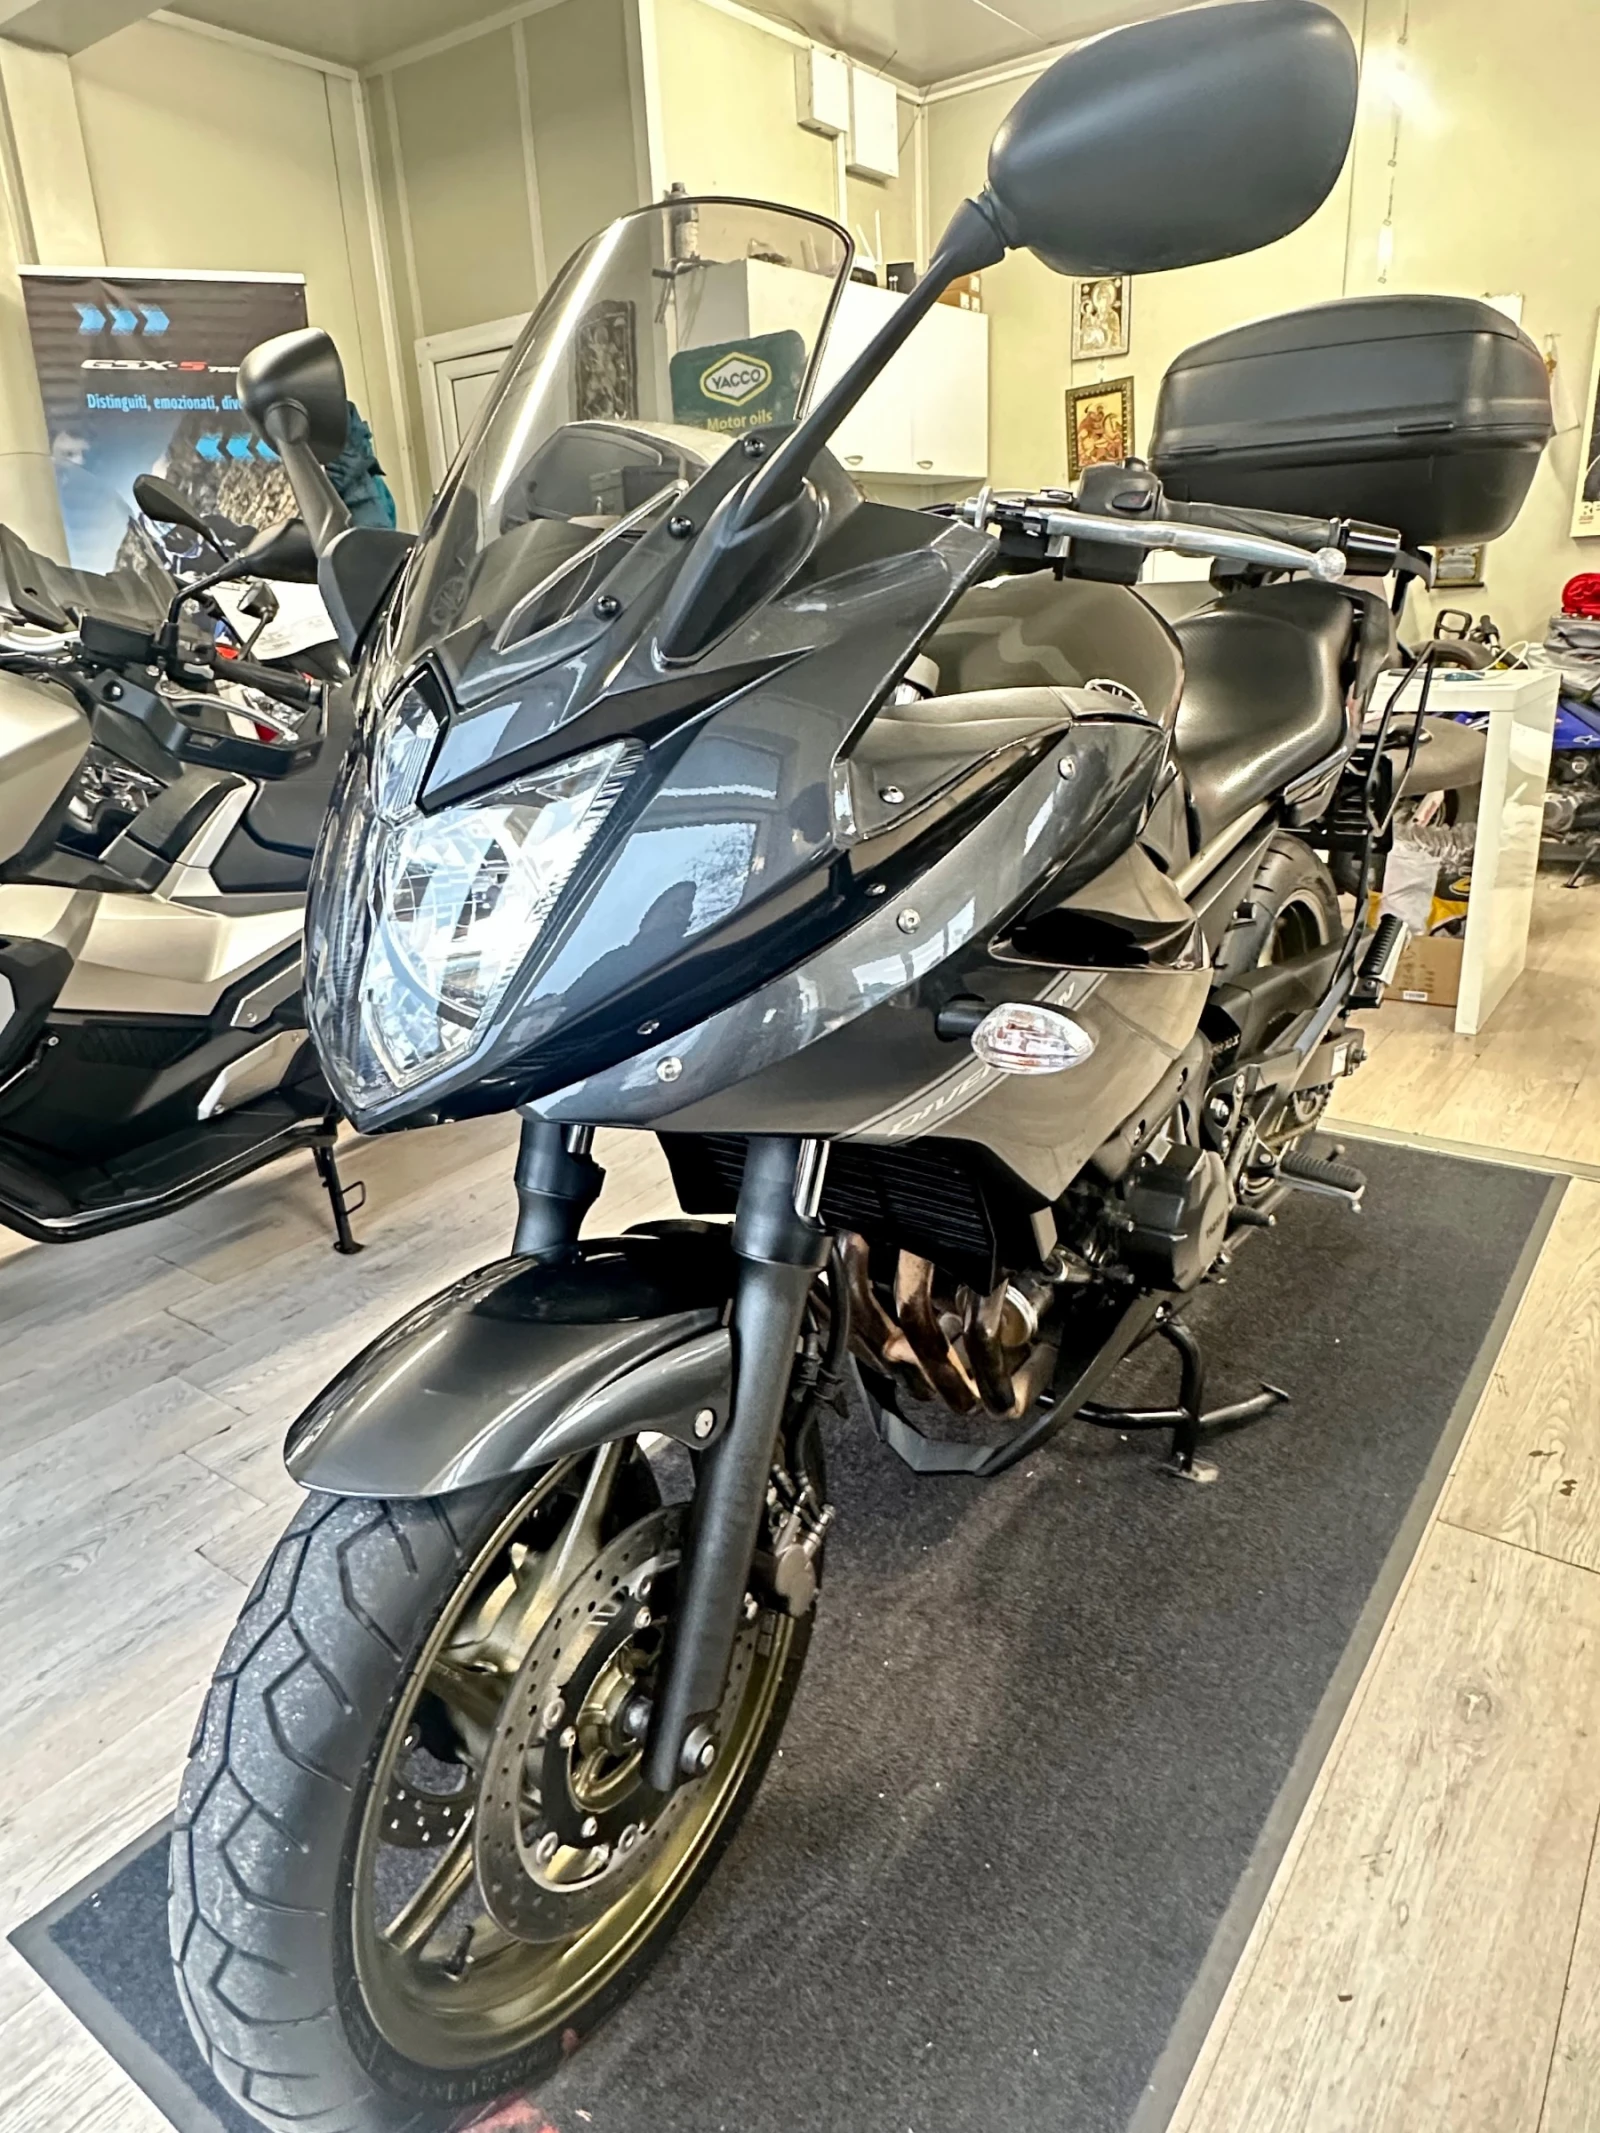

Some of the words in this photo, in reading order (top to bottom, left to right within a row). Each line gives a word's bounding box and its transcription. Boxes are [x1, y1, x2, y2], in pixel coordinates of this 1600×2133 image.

[711, 369, 761, 390] YACCO
[87, 394, 151, 412] Distinguiti,
[154, 395, 219, 412] emozionati,
[707, 415, 747, 432] Motor
[749, 409, 773, 426] oils
